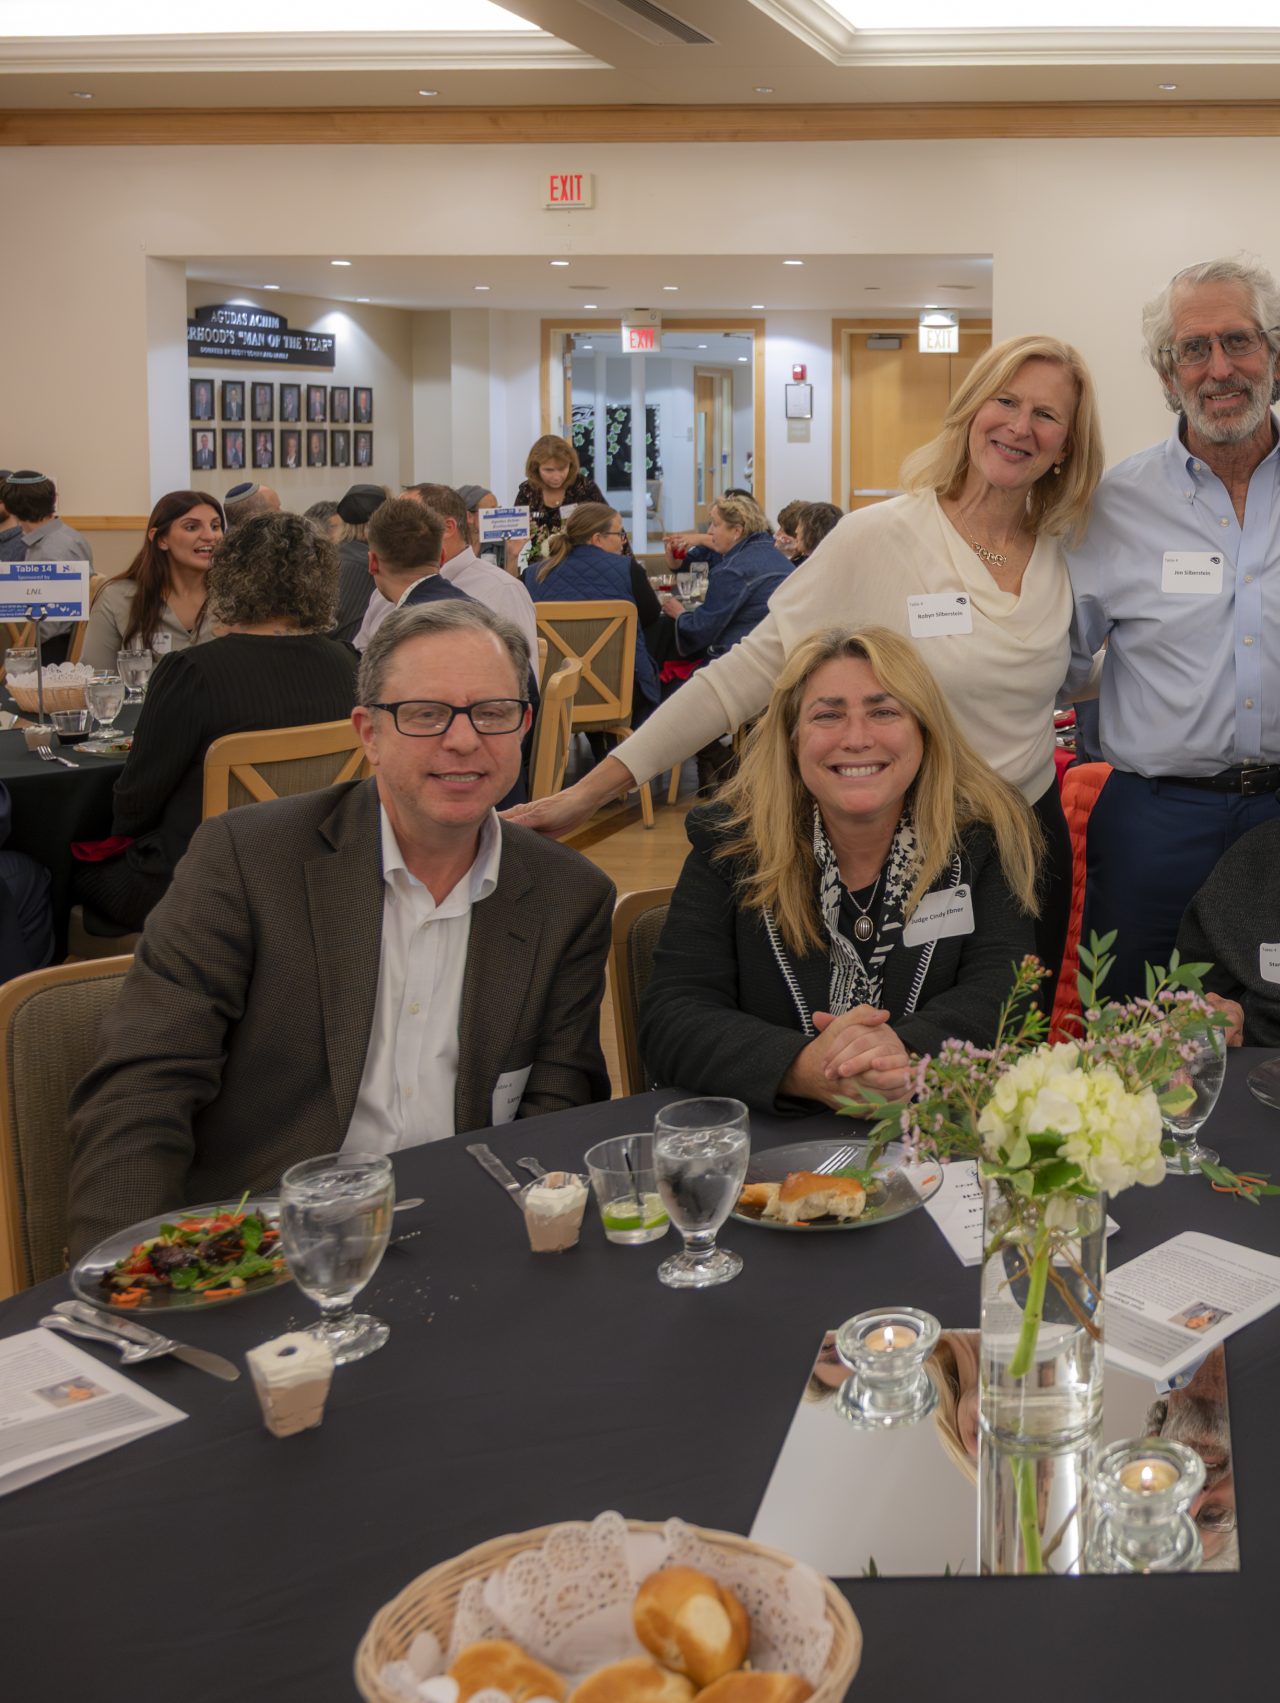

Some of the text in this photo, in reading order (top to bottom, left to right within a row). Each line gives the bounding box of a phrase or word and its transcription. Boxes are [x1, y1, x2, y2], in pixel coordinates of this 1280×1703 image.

[549, 174, 583, 201] EXIT
[211, 310, 280, 329] AGUDAS ACHIM
[269, 334, 281, 348] OF
[283, 335, 303, 350] THE
[629, 328, 656, 350] EXIT
[927, 329, 952, 350] EXIT
[16, 565, 52, 573] Table 14
[918, 612, 935, 620] Robyn
[911, 916, 928, 924] Judge
[930, 911, 946, 920] Cindy
